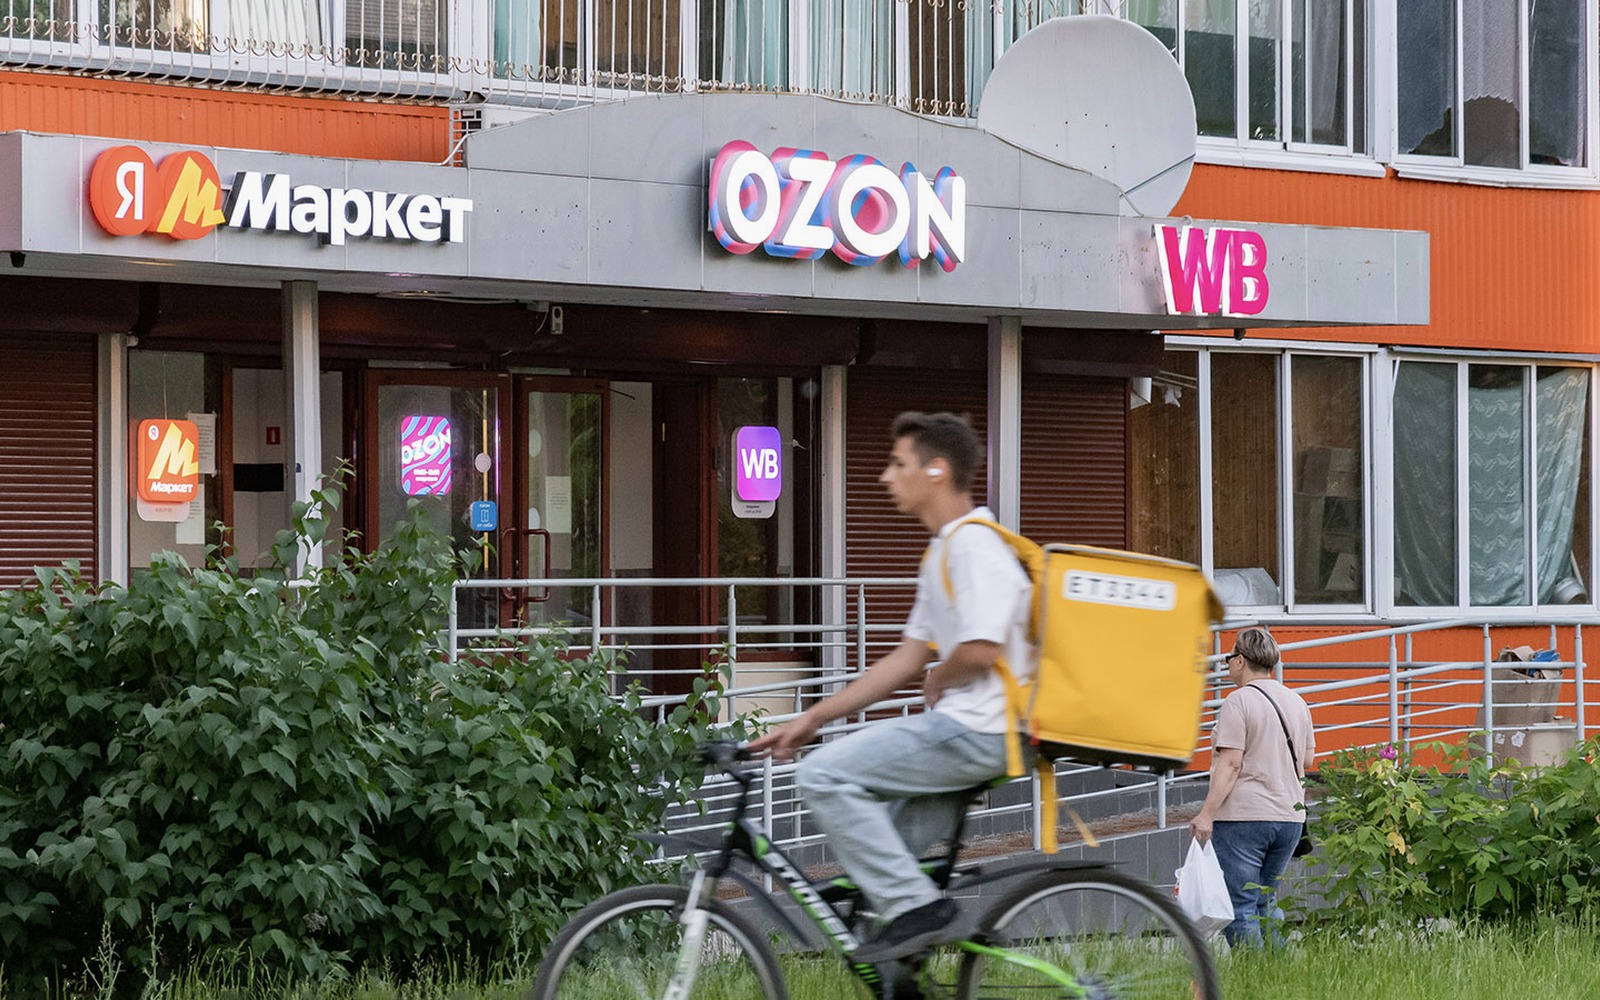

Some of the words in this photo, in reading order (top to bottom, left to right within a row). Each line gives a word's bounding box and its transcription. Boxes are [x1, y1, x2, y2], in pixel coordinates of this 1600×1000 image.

[115, 161, 144, 220] Я
[228, 170, 473, 246] Маркет
[709, 148, 967, 264] OZON
[1154, 223, 1270, 317] WB
[402, 428, 451, 464] OZON
[740, 448, 779, 479] WB
[150, 481, 194, 494] Маркет
